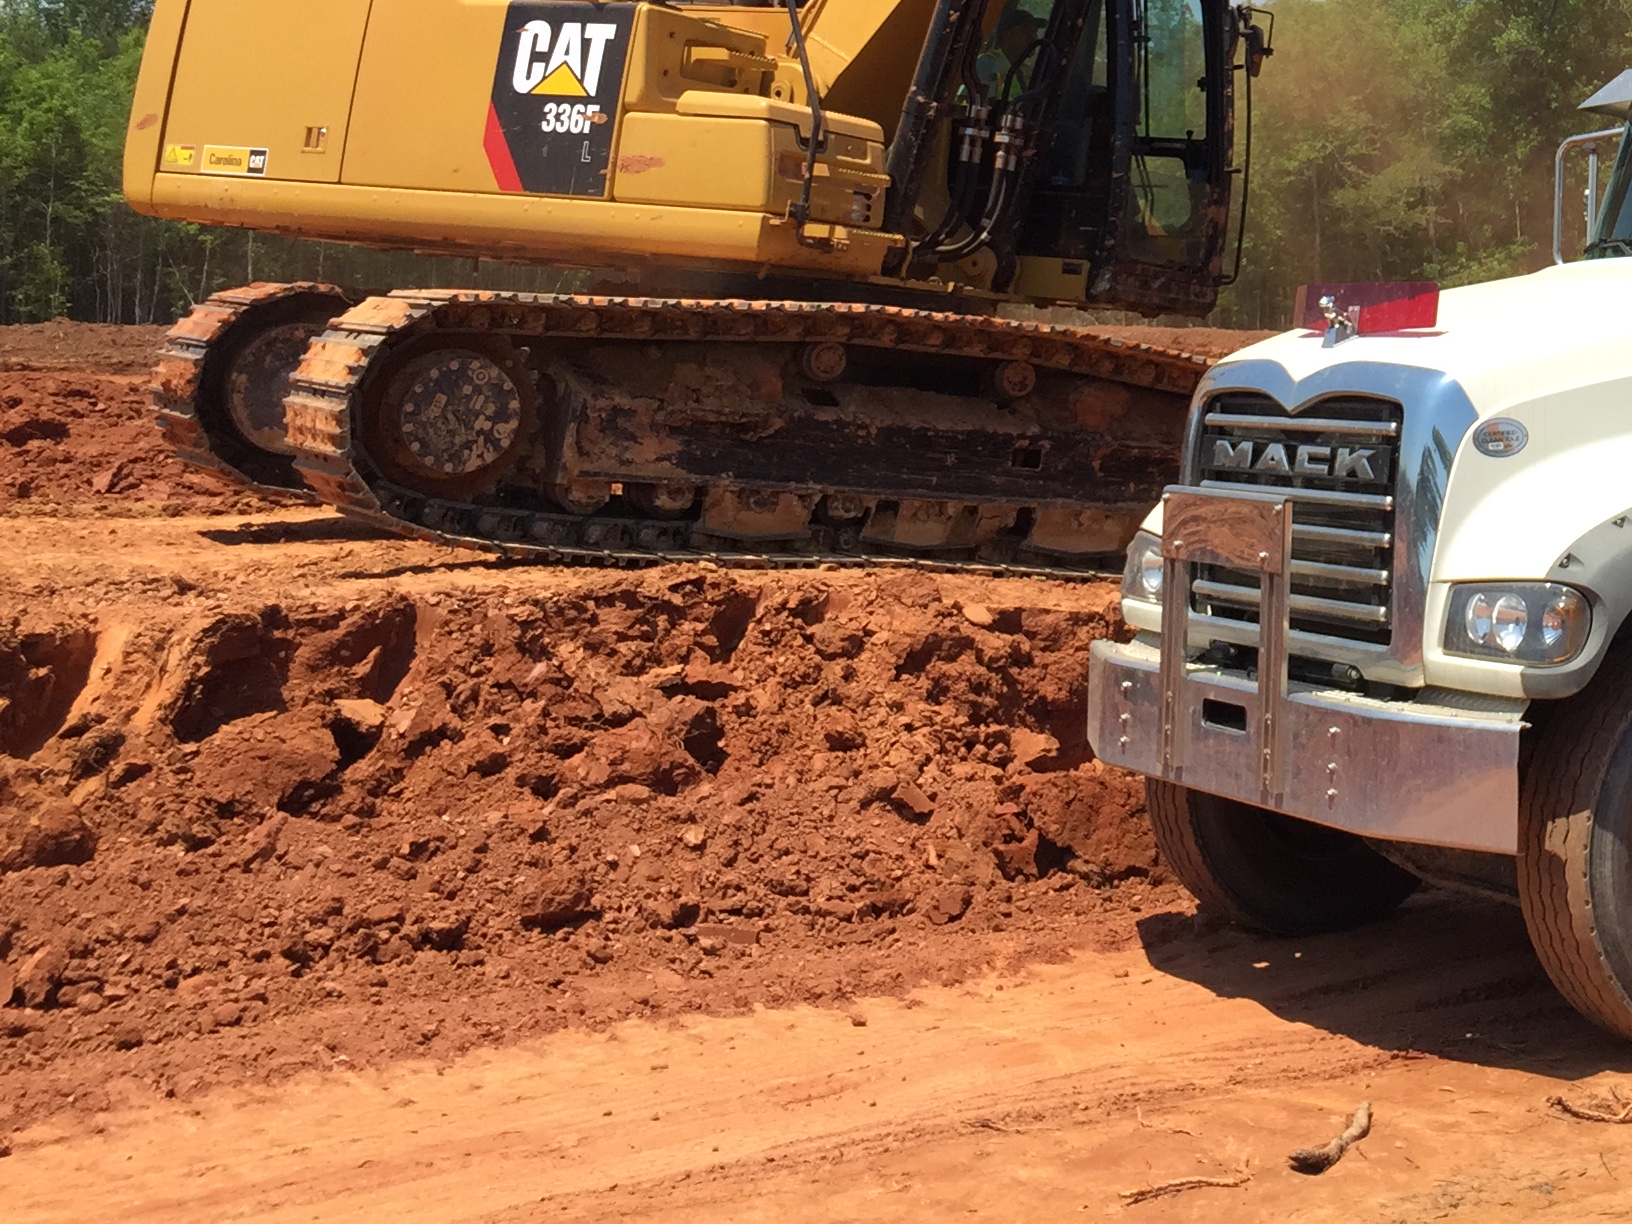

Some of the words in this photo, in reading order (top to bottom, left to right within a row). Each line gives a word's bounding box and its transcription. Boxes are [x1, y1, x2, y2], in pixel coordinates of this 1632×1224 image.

[512, 19, 617, 97] CAT
[541, 102, 601, 134] 336F
[209, 153, 242, 167] Carolina
[249, 155, 265, 168] CAT
[580, 140, 592, 163] L
[1213, 439, 1377, 480] MACK
